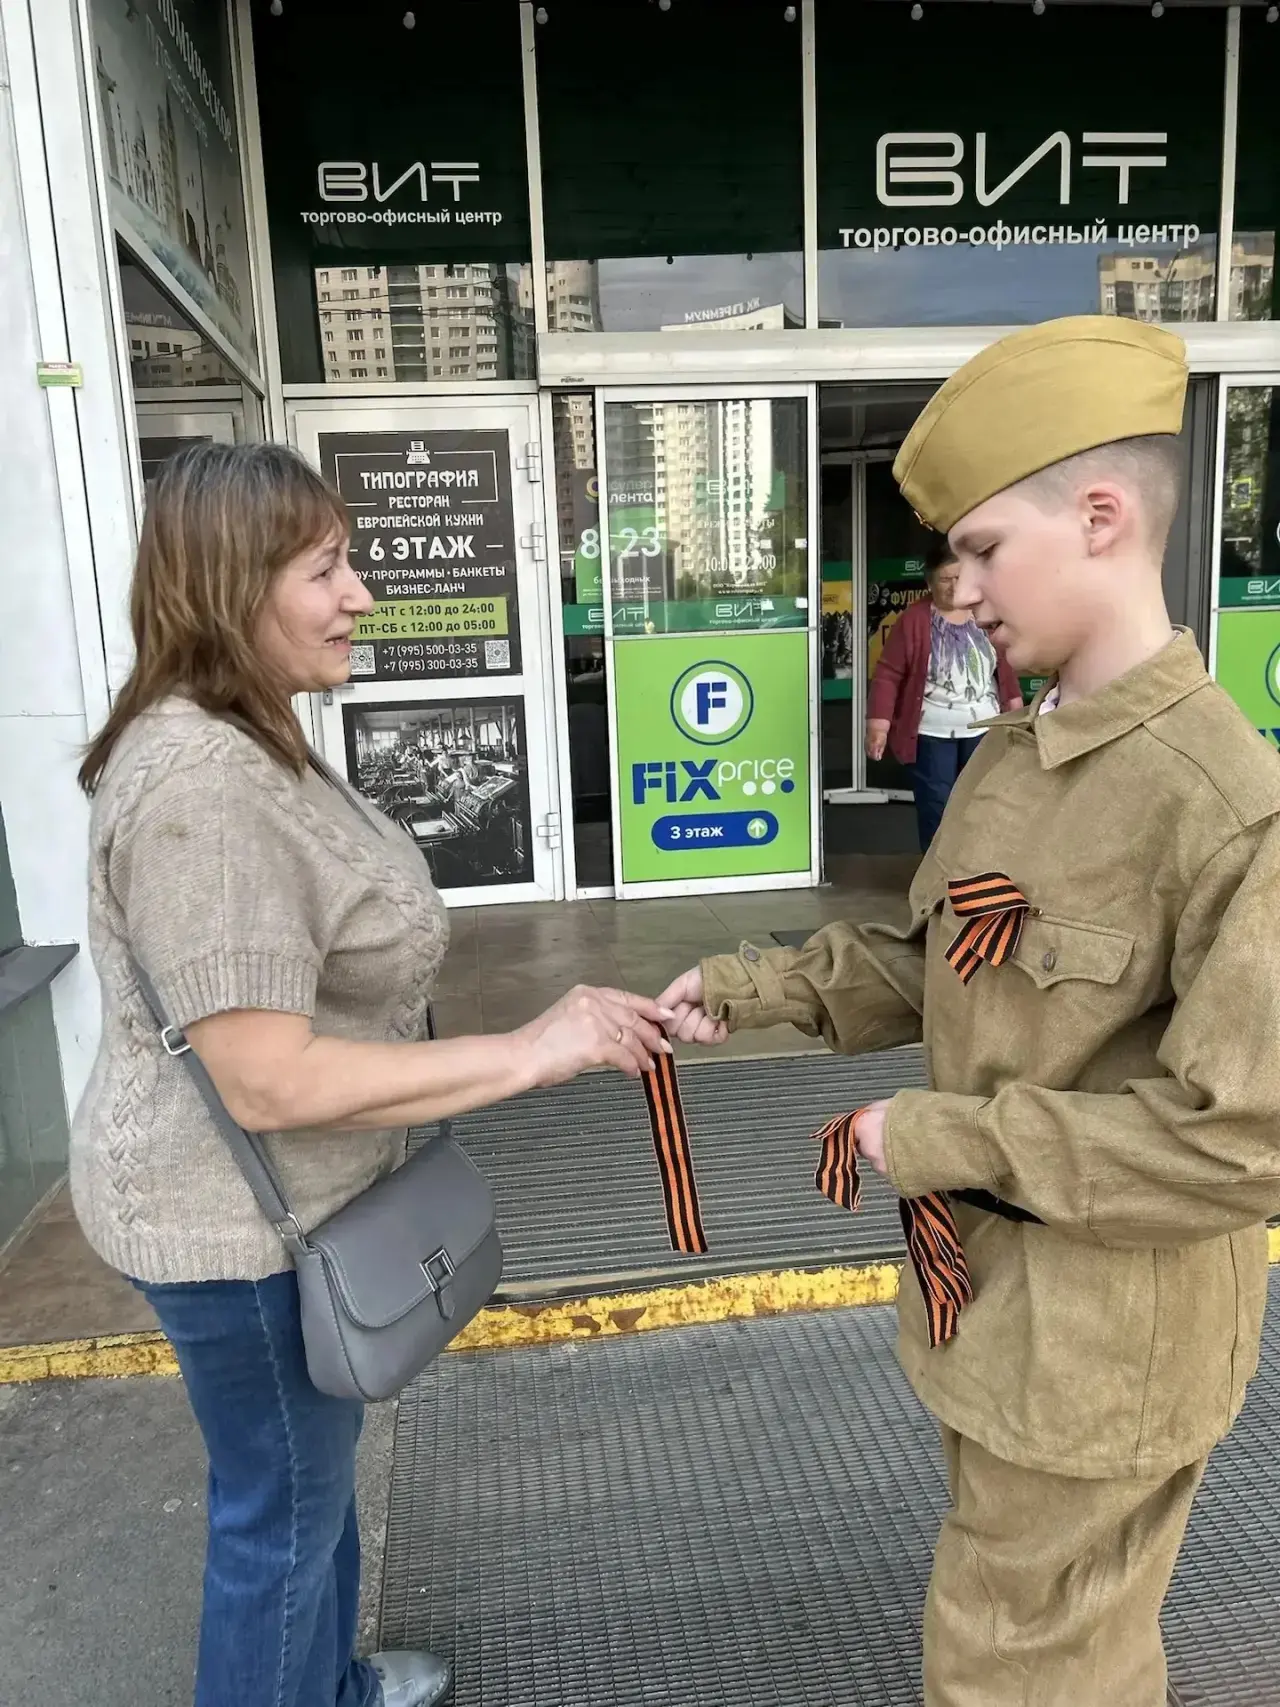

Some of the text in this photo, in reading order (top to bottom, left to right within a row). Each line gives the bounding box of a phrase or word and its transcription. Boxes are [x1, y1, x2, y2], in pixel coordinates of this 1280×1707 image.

[157, 0, 233, 154] омическое
[876, 131, 1168, 206] ВИТ
[318, 161, 480, 202] ВИТ
[300, 208, 502, 227] торгово-офисный центр
[838, 218, 1200, 252] торгово-офисный центр
[360, 470, 479, 490] ТИПОГРАФИЯ
[388, 494, 450, 509] РЕСТОРАН
[609, 492, 654, 504] лента
[357, 513, 484, 529] ЕВРОПЕЙСКОЙ КУХНИ
[369, 535, 476, 561] 6 ЭТАЖ
[356, 566, 506, 581] ОУ-ПРОГРАММЫ БАНКЕТЫ
[386, 583, 466, 596] БИЗНЕС-ЛАНЧ
[1247, 580, 1280, 594] ВИ
[410, 604, 442, 616] 12:00
[444, 605, 459, 616] до
[462, 602, 495, 614] 24:00
[359, 622, 398, 635] ПТ-СБ
[412, 620, 443, 632] 12:00
[445, 621, 461, 633] до
[463, 619, 496, 631] 05:00
[382, 643, 477, 658] +7 (995) 500-03-35
[383, 658, 478, 672] +7 (995) 300-03-35
[670, 824, 724, 839] 3 этаж
